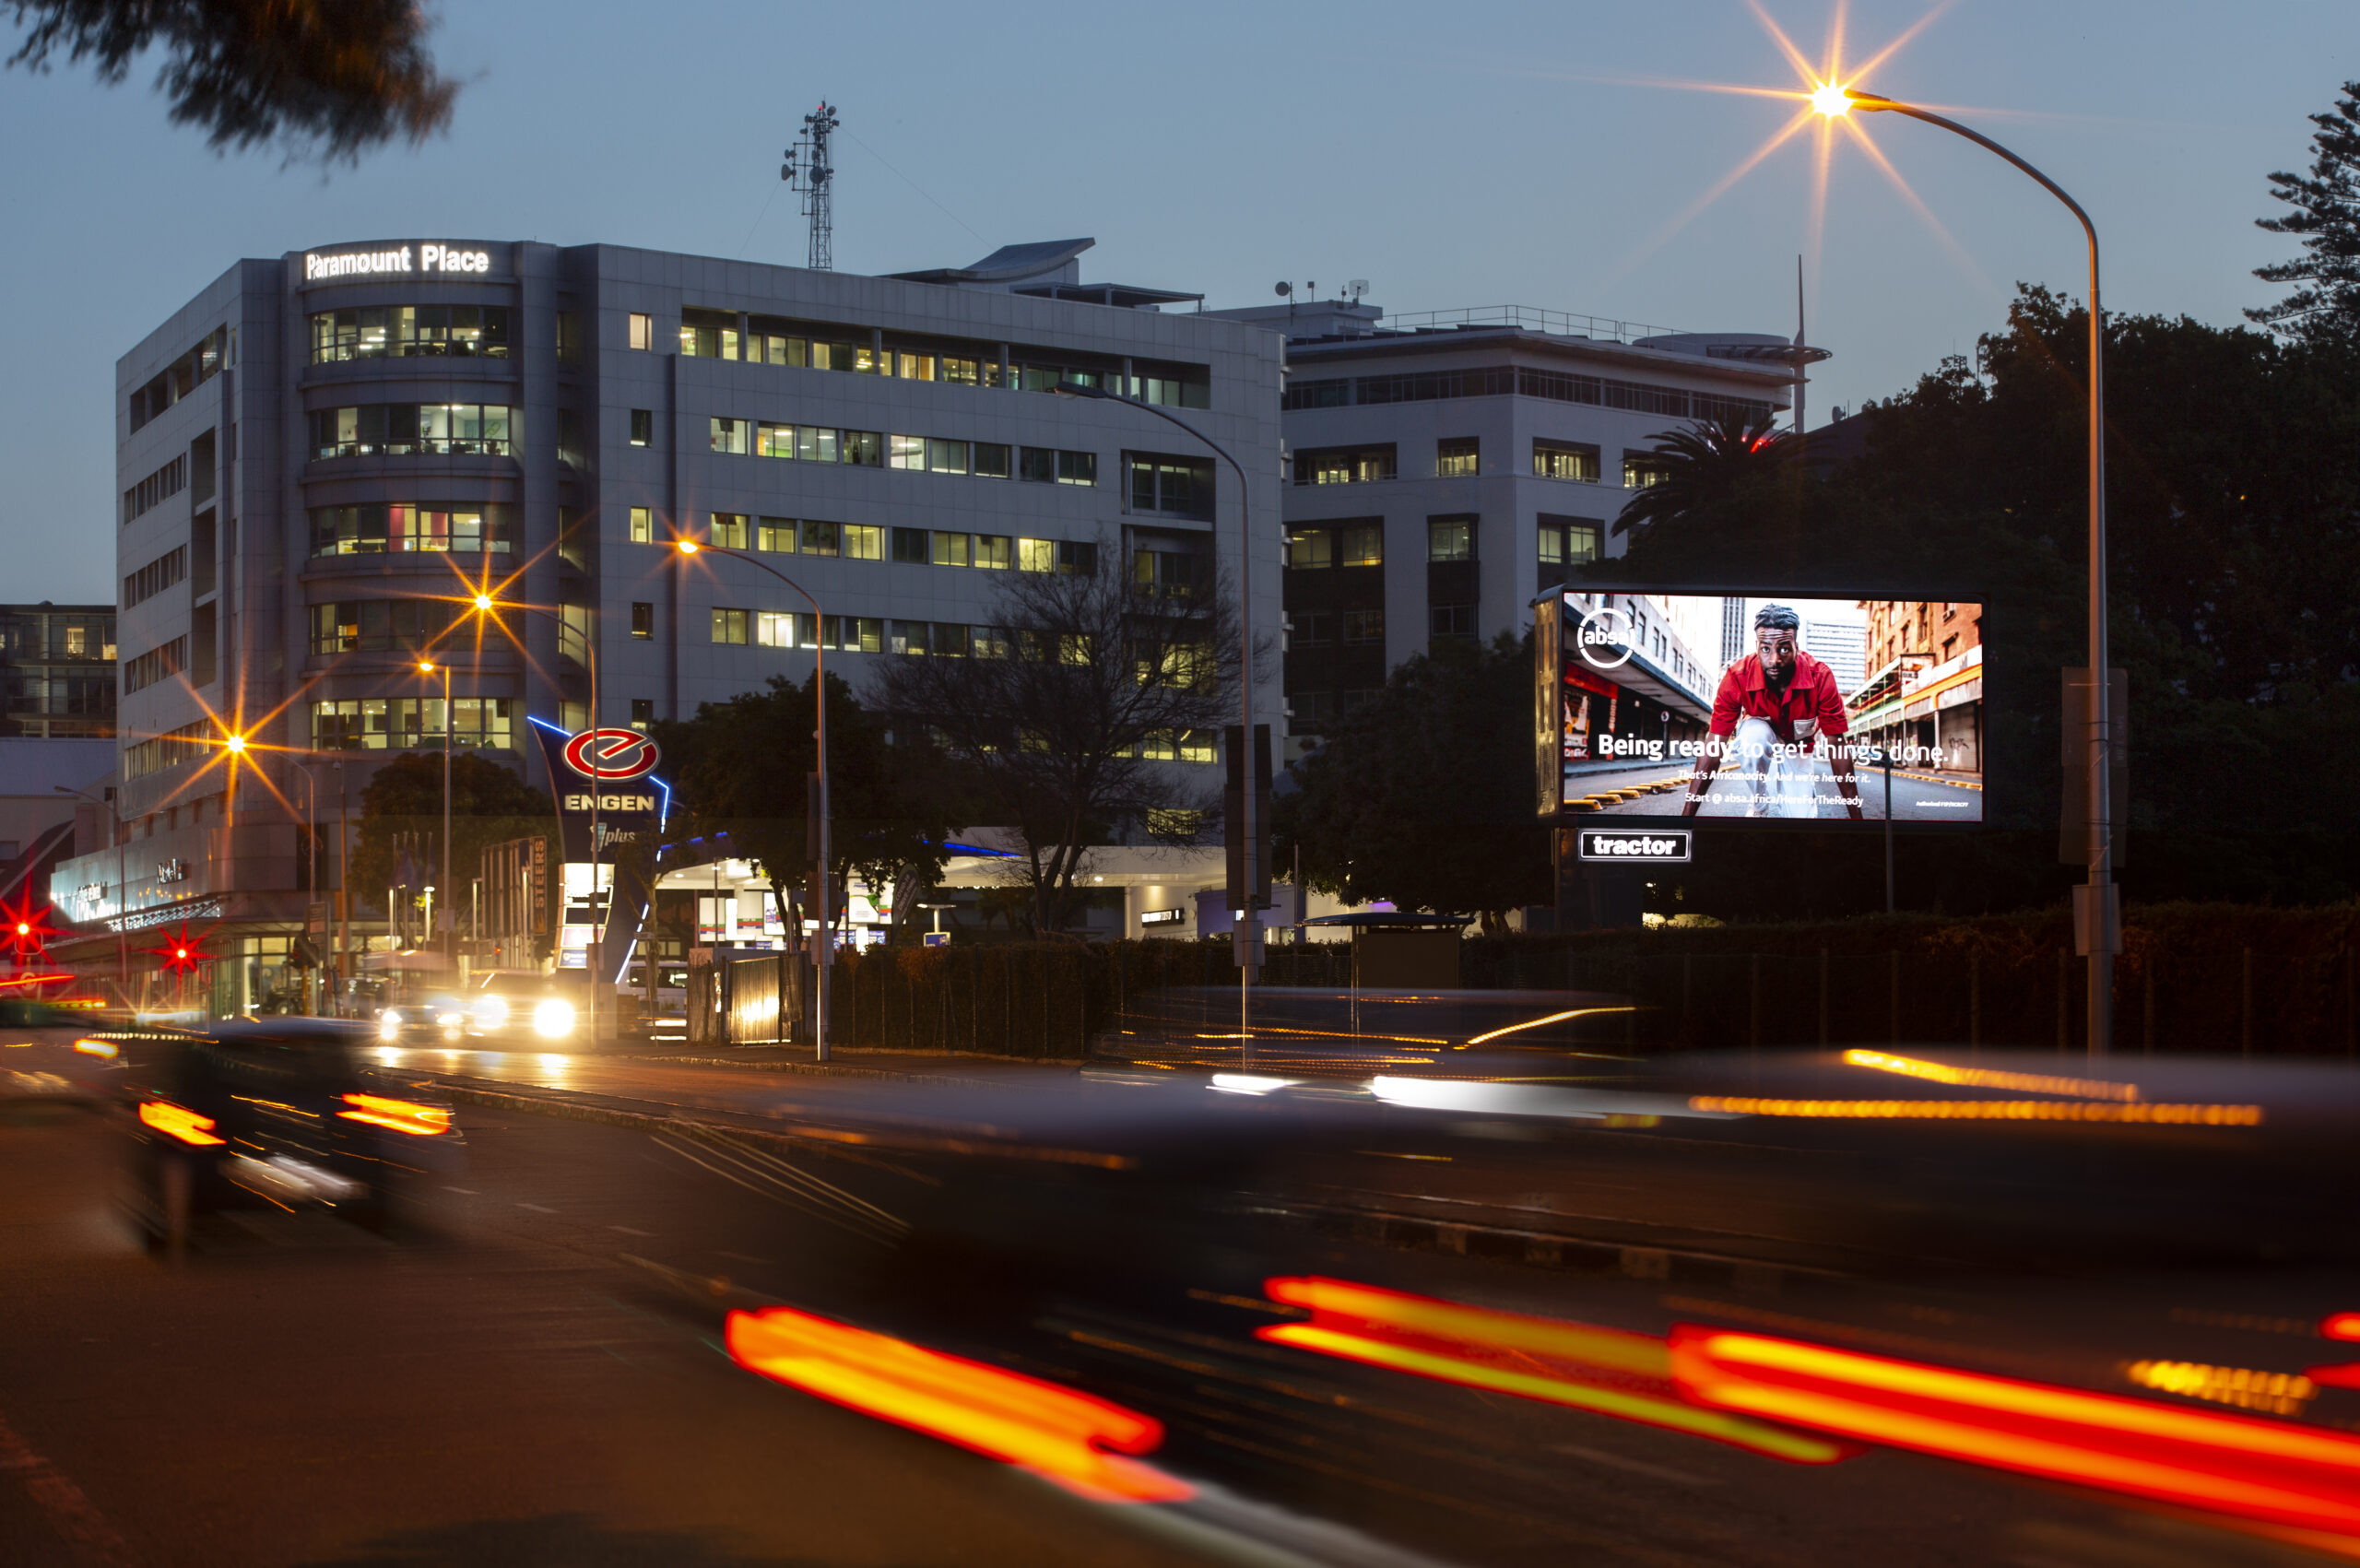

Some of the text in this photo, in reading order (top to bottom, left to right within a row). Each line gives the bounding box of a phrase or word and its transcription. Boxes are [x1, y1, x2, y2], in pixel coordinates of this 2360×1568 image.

[306, 245, 490, 280] Paramount Place
[1584, 626, 1630, 645] absa
[1599, 733, 1949, 766] Being ready to get things done.
[1775, 772, 1793, 783] And
[1822, 772, 1844, 783] here
[1845, 772, 1859, 784] for
[1860, 772, 1871, 784] it.
[565, 795, 655, 810] ENGEN
[1685, 793, 1710, 803] Start
[1712, 793, 1722, 804] @
[1592, 835, 1677, 855] tractor
[535, 840, 545, 908] STEERS
